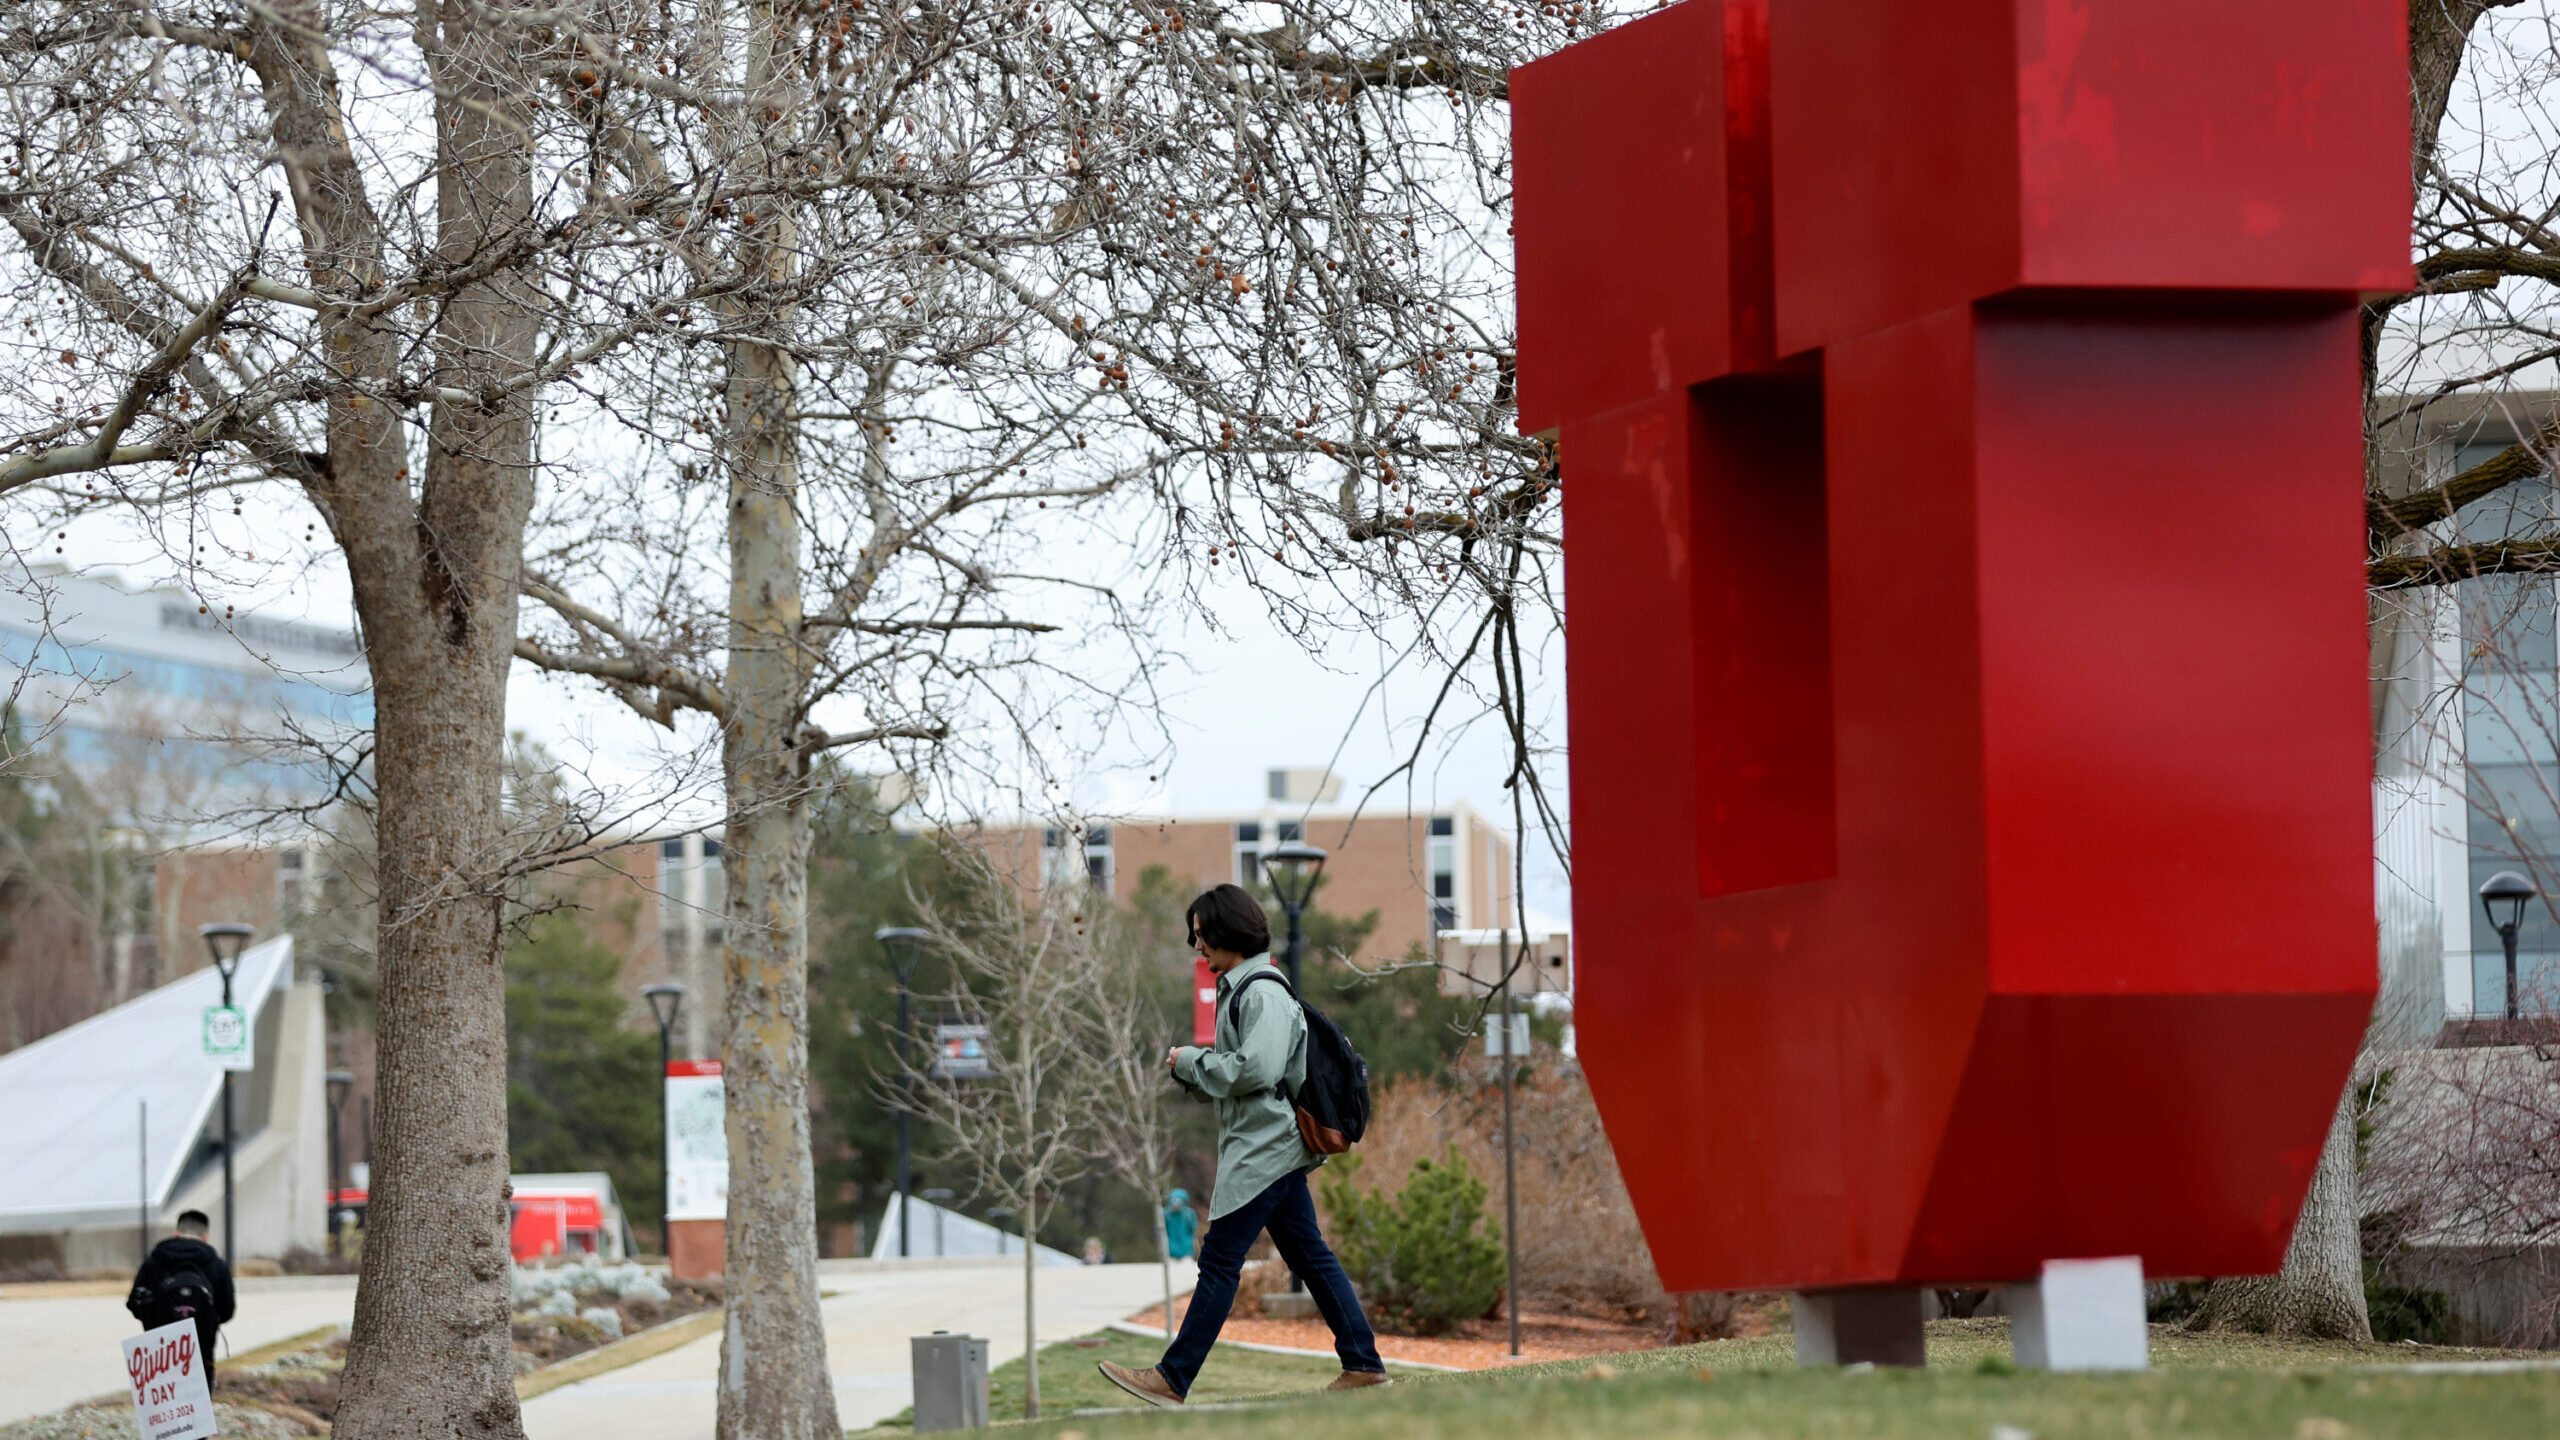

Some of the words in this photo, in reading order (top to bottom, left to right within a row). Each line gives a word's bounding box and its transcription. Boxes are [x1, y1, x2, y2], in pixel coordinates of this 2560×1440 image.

[127, 1333, 196, 1406] Giving
[151, 1381, 175, 1405] DAY
[176, 1404, 194, 1418] 2024
